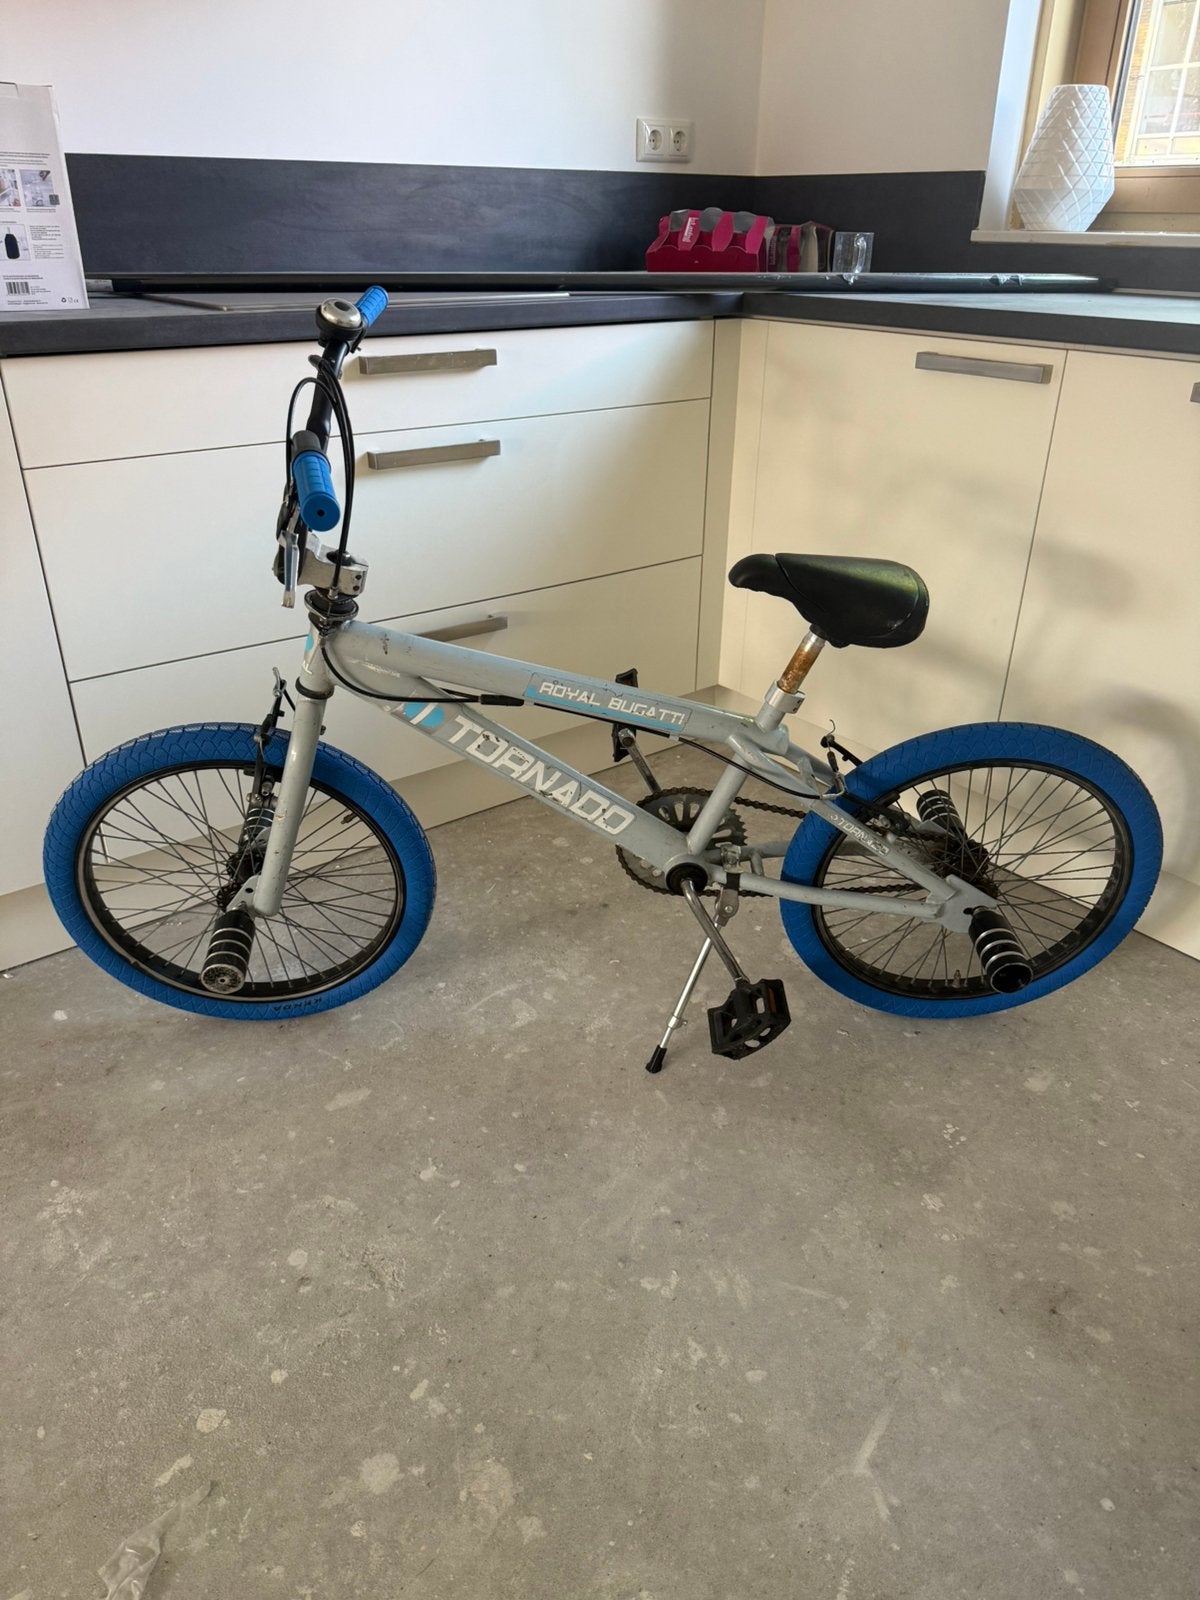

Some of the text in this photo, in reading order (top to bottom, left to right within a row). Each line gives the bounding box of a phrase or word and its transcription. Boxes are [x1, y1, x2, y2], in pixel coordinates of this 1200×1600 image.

[538, 681, 686, 725] ROYAL BUGATTI
[448, 715, 636, 836] TORNADO
